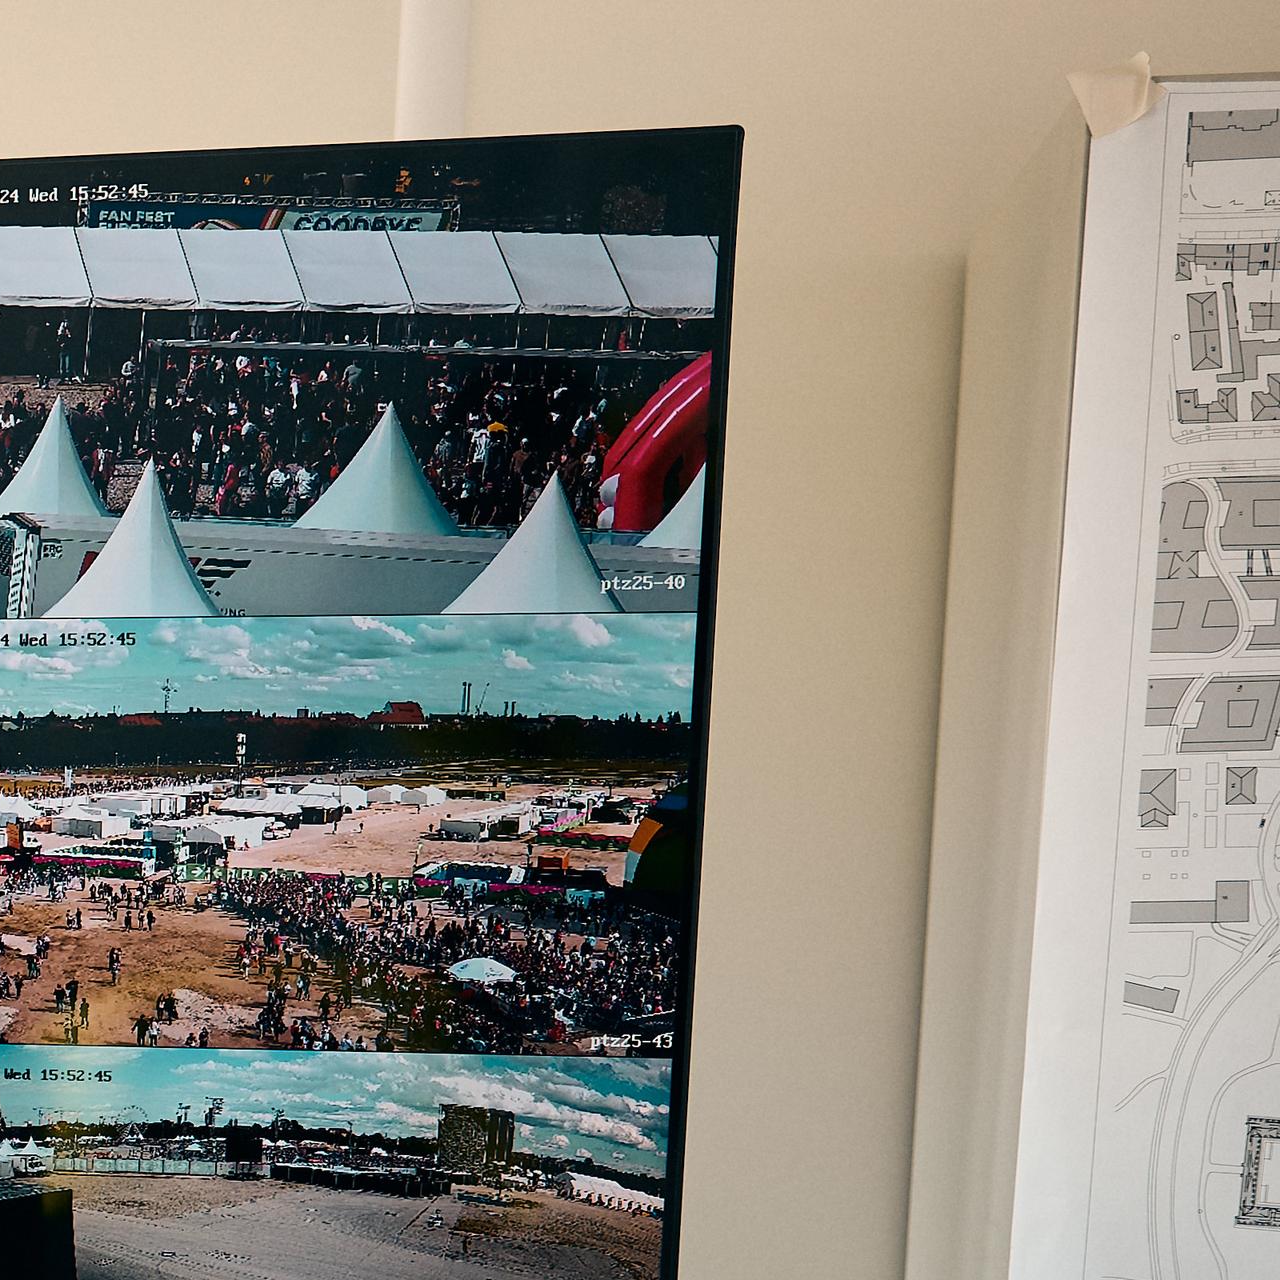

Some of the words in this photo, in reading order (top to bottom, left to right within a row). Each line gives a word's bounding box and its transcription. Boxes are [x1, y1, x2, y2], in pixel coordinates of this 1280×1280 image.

[29, 188, 59, 202] Wed
[70, 184, 149, 201] 15:52:45
[98, 210, 131, 221] FAN
[600, 575, 686, 594] ptz25-40
[19, 632, 48, 647] Wed
[59, 632, 136, 646] 15:52:45
[590, 1032, 674, 1051] ptz25-43
[4, 1068, 31, 1080] Wed
[41, 1069, 112, 1082] 15:52:45
